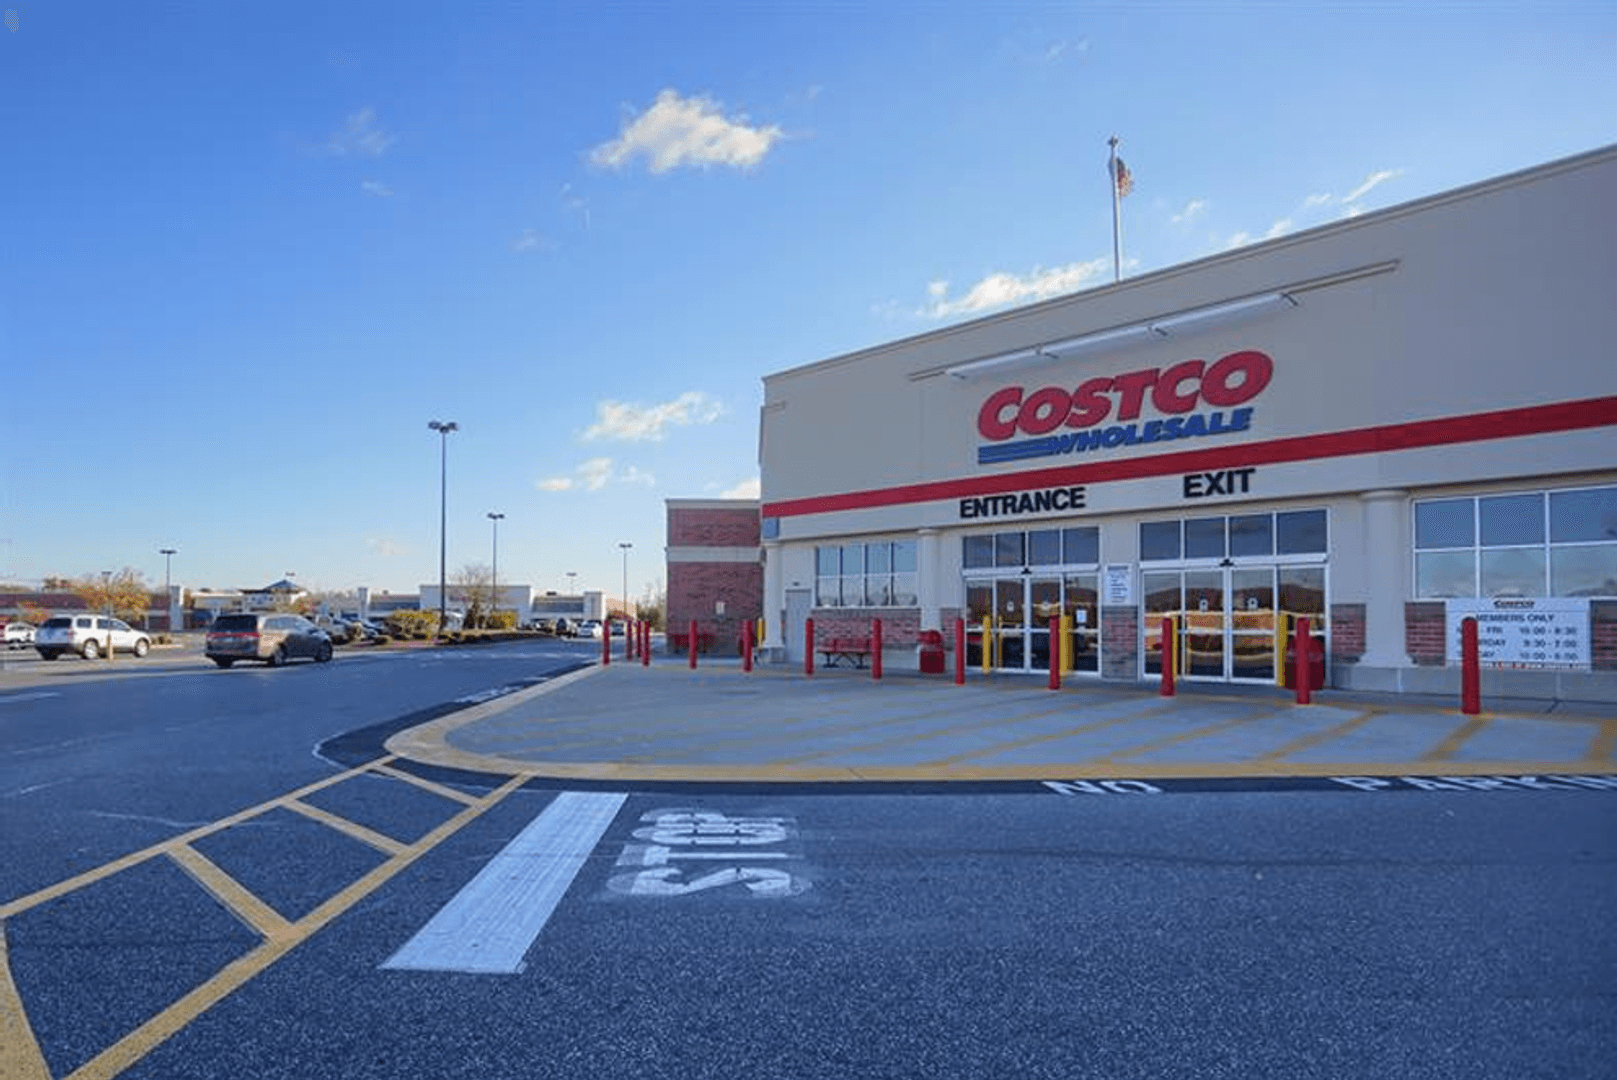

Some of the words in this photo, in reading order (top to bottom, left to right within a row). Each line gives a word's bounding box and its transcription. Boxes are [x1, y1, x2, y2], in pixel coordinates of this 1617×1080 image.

[977, 349, 1274, 441] COSTCO
[1049, 407, 1254, 455] WHOLESALE
[1184, 468, 1256, 498] EXIT
[959, 487, 1086, 519] ENTRANCE
[1527, 613, 1554, 622] ONLY
[1042, 780, 1162, 795] NO
